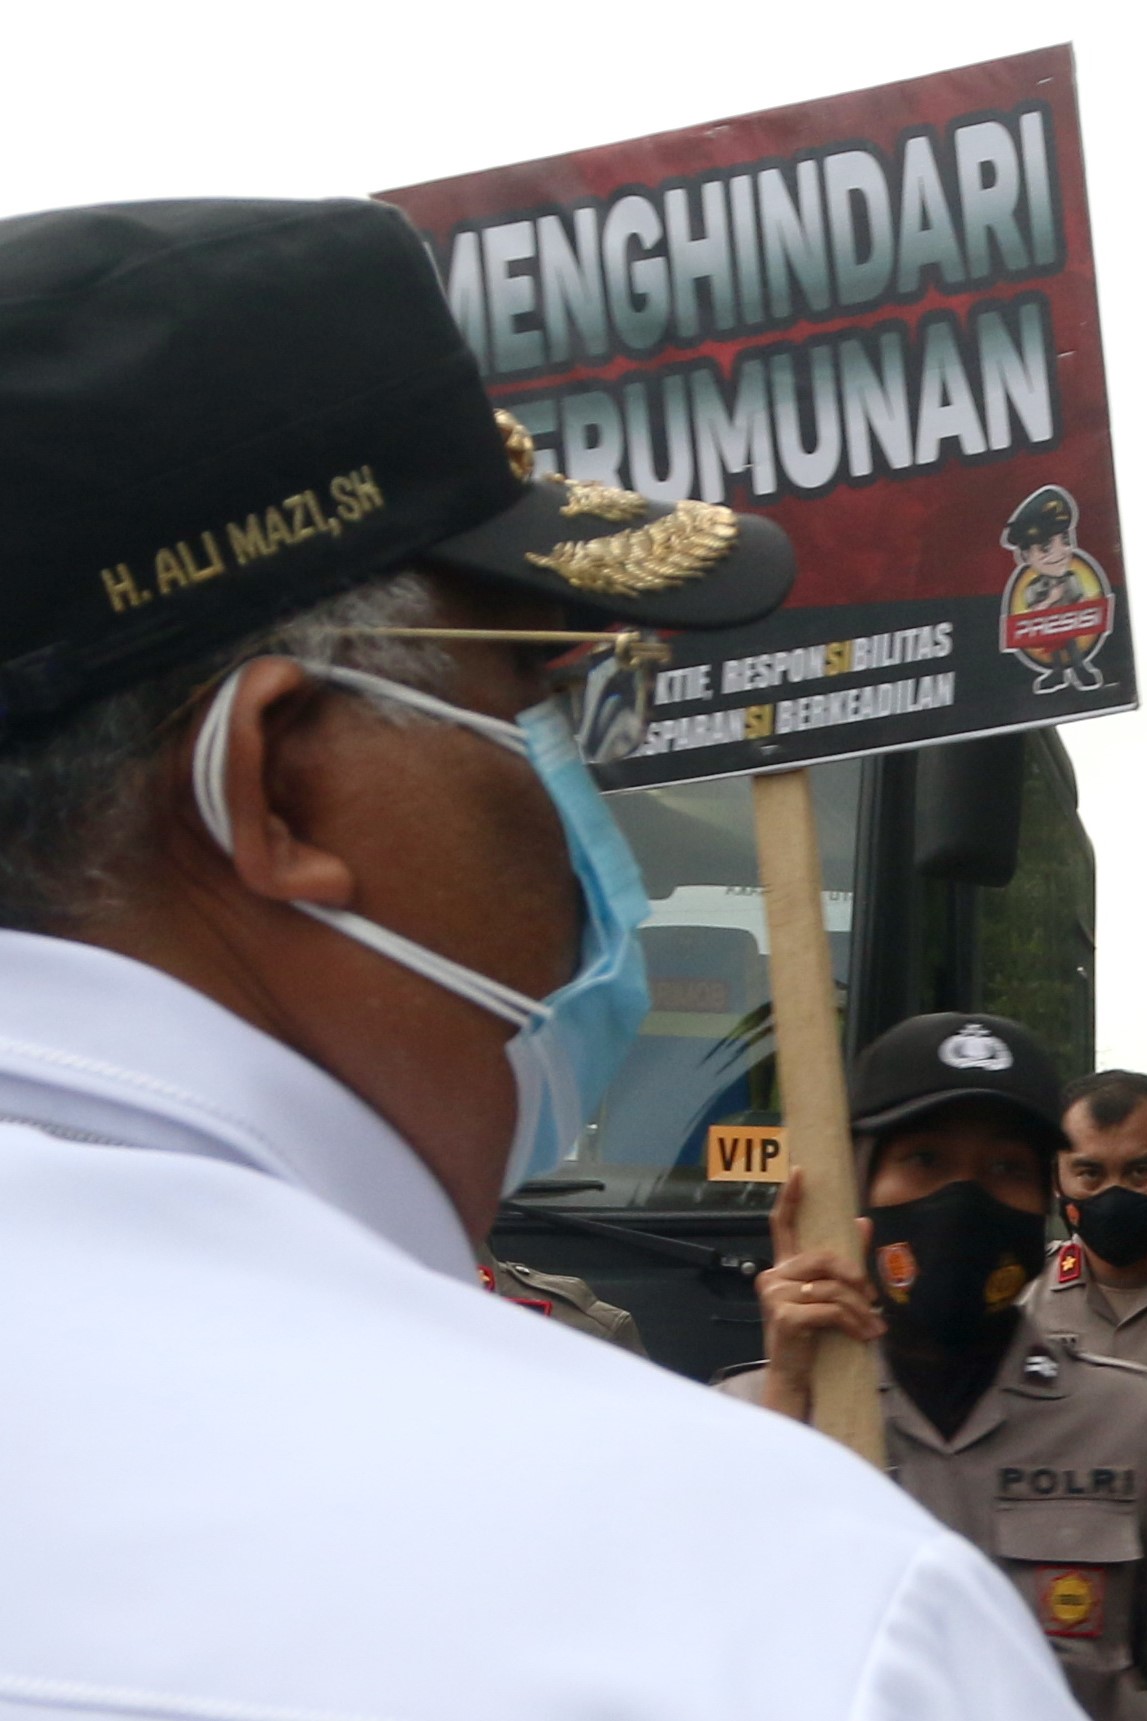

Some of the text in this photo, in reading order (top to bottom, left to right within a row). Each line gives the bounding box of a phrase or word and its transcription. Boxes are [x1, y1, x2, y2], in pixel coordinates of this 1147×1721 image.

[101, 563, 152, 613] H.
[155, 531, 225, 595] ALI
[721, 622, 953, 694] RESPONSIBILITAS
[775, 671, 955, 735] BERKEADILAN
[718, 1137, 780, 1173] VIP
[1000, 1467, 1136, 1495] POLRI
